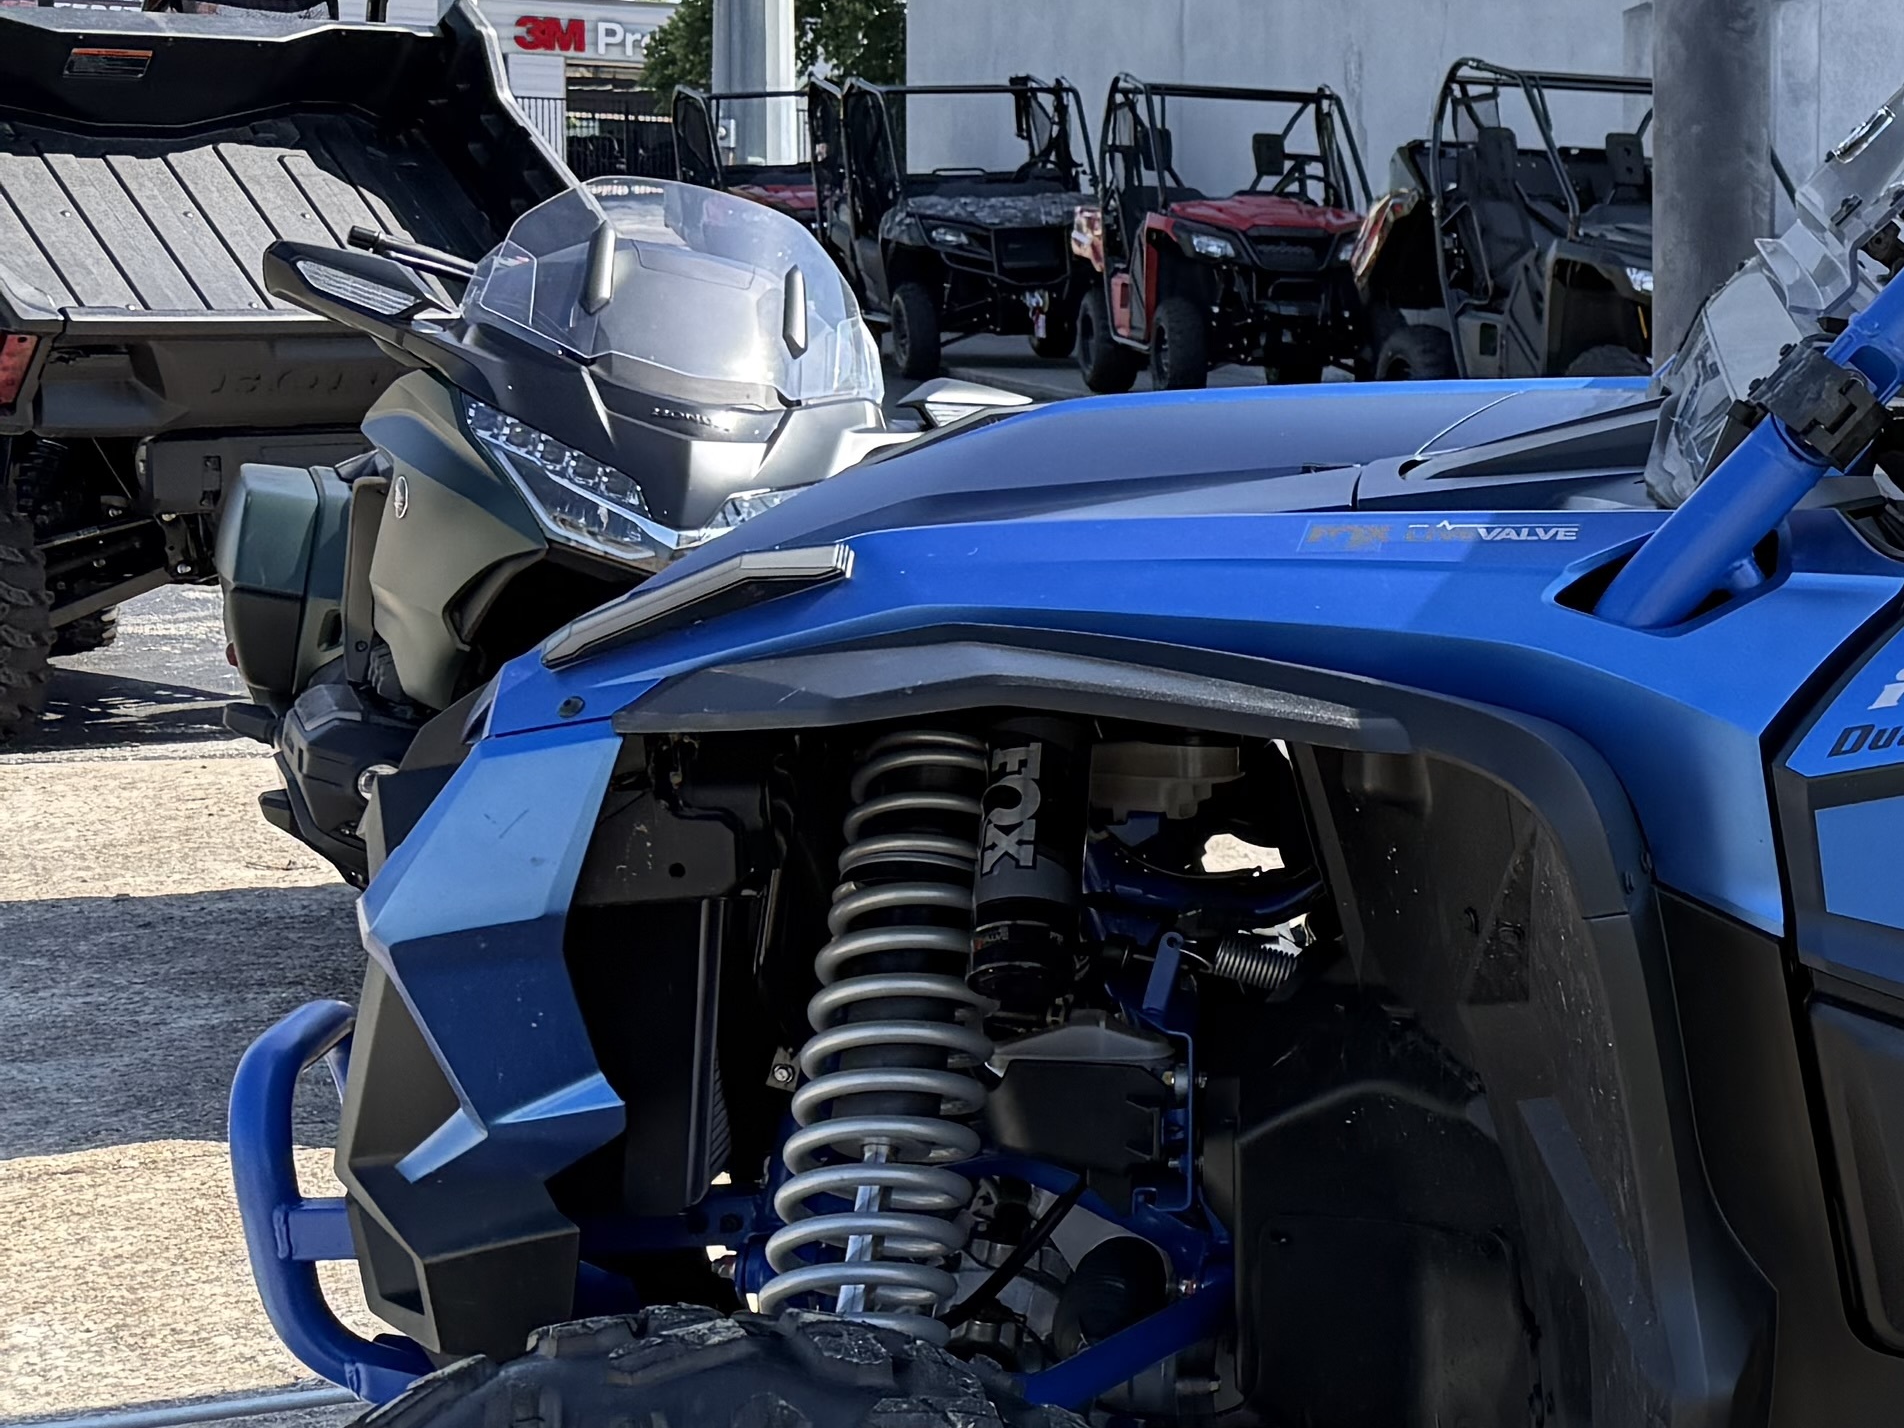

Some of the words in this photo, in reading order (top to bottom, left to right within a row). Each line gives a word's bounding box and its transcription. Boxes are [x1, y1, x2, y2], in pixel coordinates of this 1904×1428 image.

[513, 16, 585, 53] 3M
[1476, 526, 1579, 541] VALVE
[981, 741, 1042, 876] FOX
